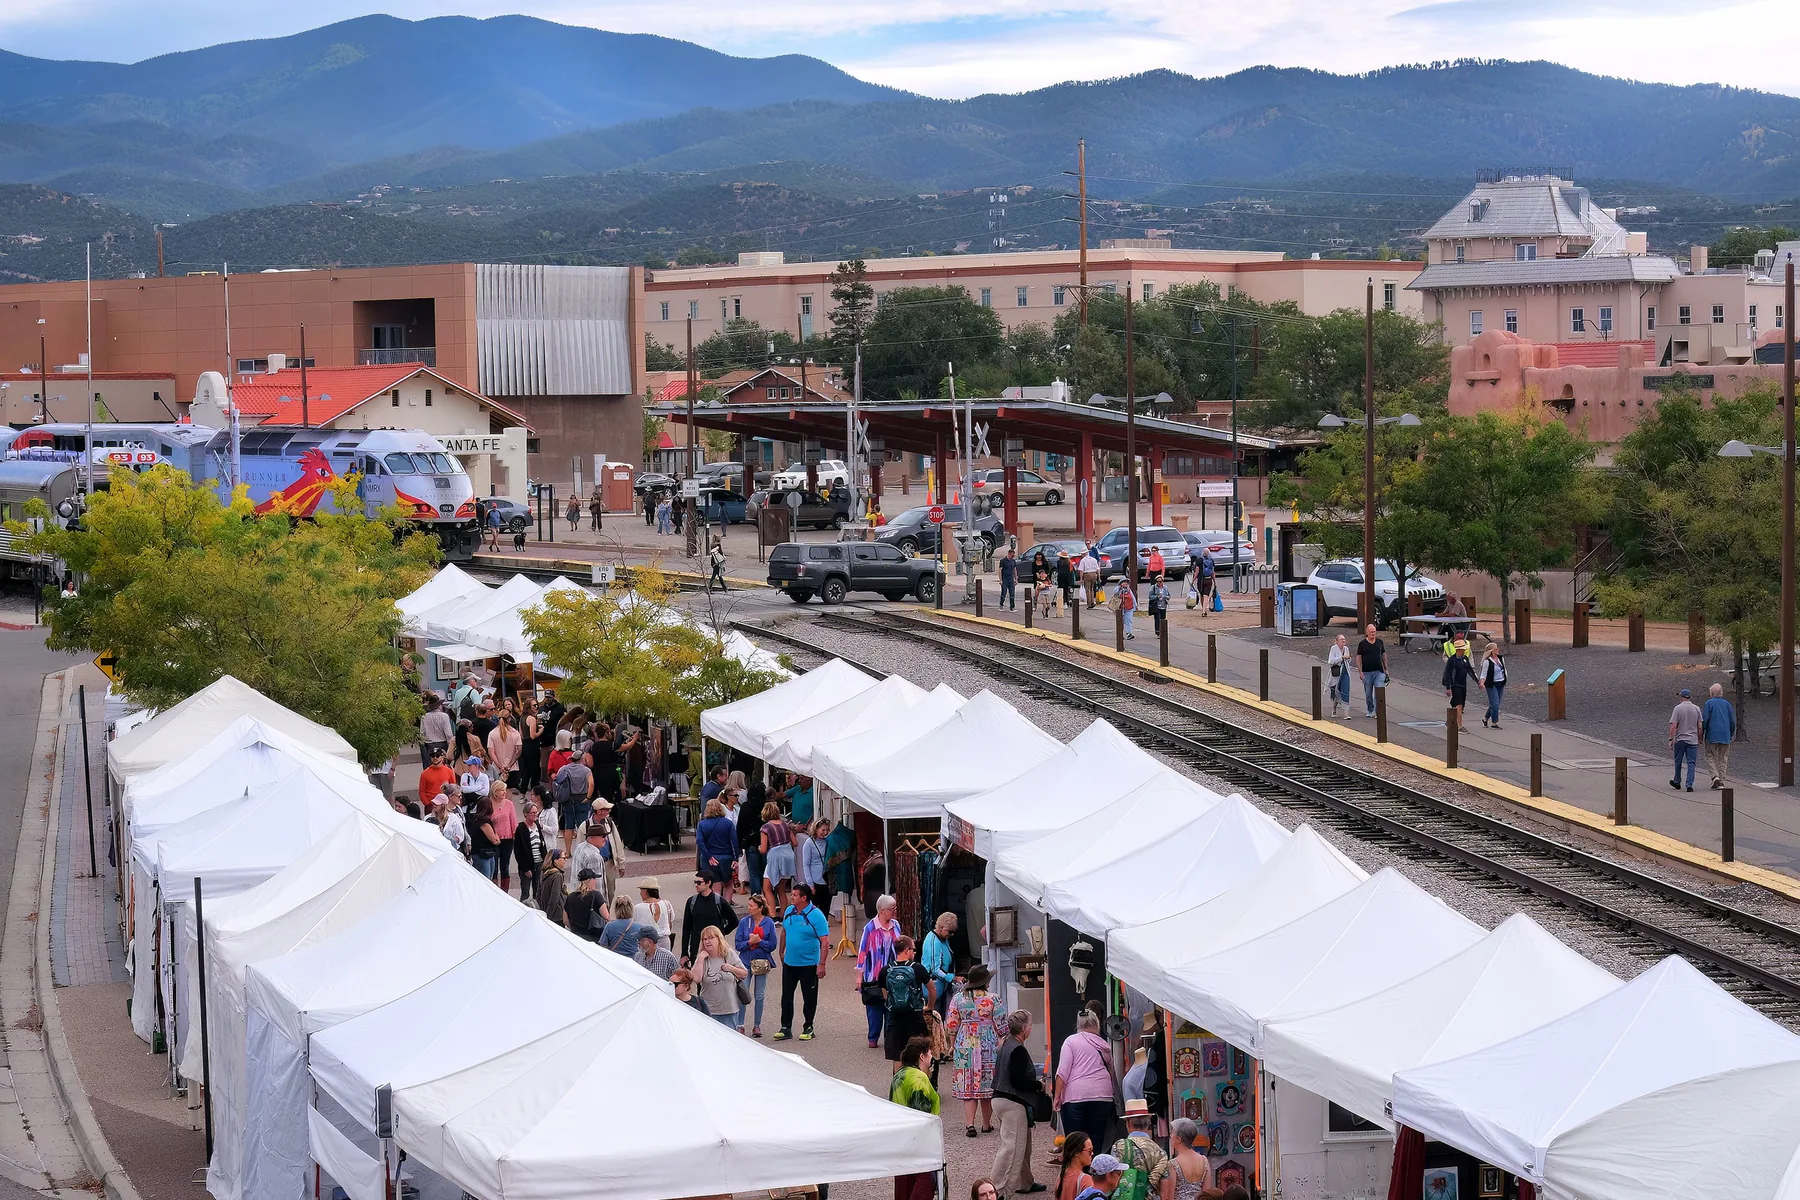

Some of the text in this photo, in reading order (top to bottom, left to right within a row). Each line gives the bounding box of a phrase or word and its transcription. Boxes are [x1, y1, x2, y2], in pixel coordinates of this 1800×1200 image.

[483, 438, 500, 450] FE
[1246, 438, 1269, 447] CAUTION
[113, 453, 129, 461] 93
[140, 453, 153, 461] 93
[245, 472, 287, 482] RUNNER
[929, 511, 944, 519] STOP
[601, 572, 607, 581] R
